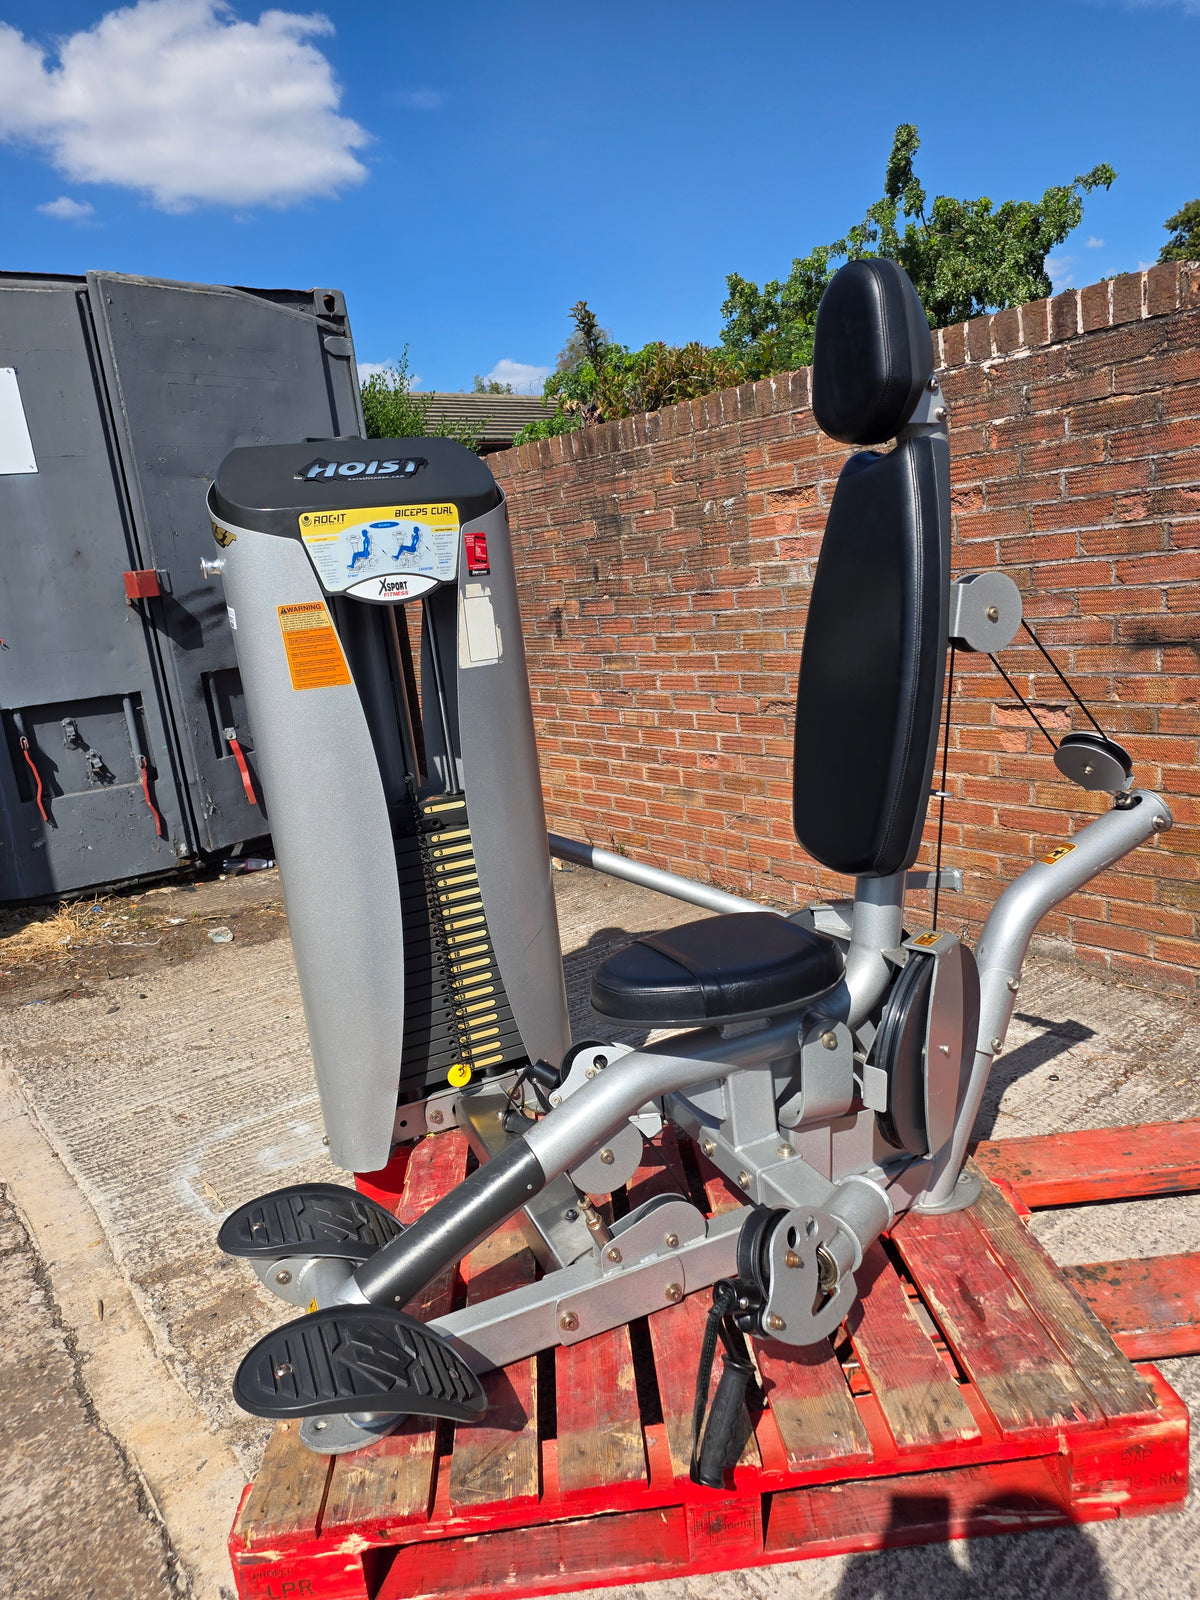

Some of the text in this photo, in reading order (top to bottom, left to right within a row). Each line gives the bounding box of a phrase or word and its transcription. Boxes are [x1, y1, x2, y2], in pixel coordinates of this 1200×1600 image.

[307, 459, 418, 478] HOIST
[395, 506, 453, 518] BICEPS CURL
[383, 590, 409, 598] FITNESS
[286, 603, 322, 613] WARNING
[267, 1579, 314, 1599] LPR
